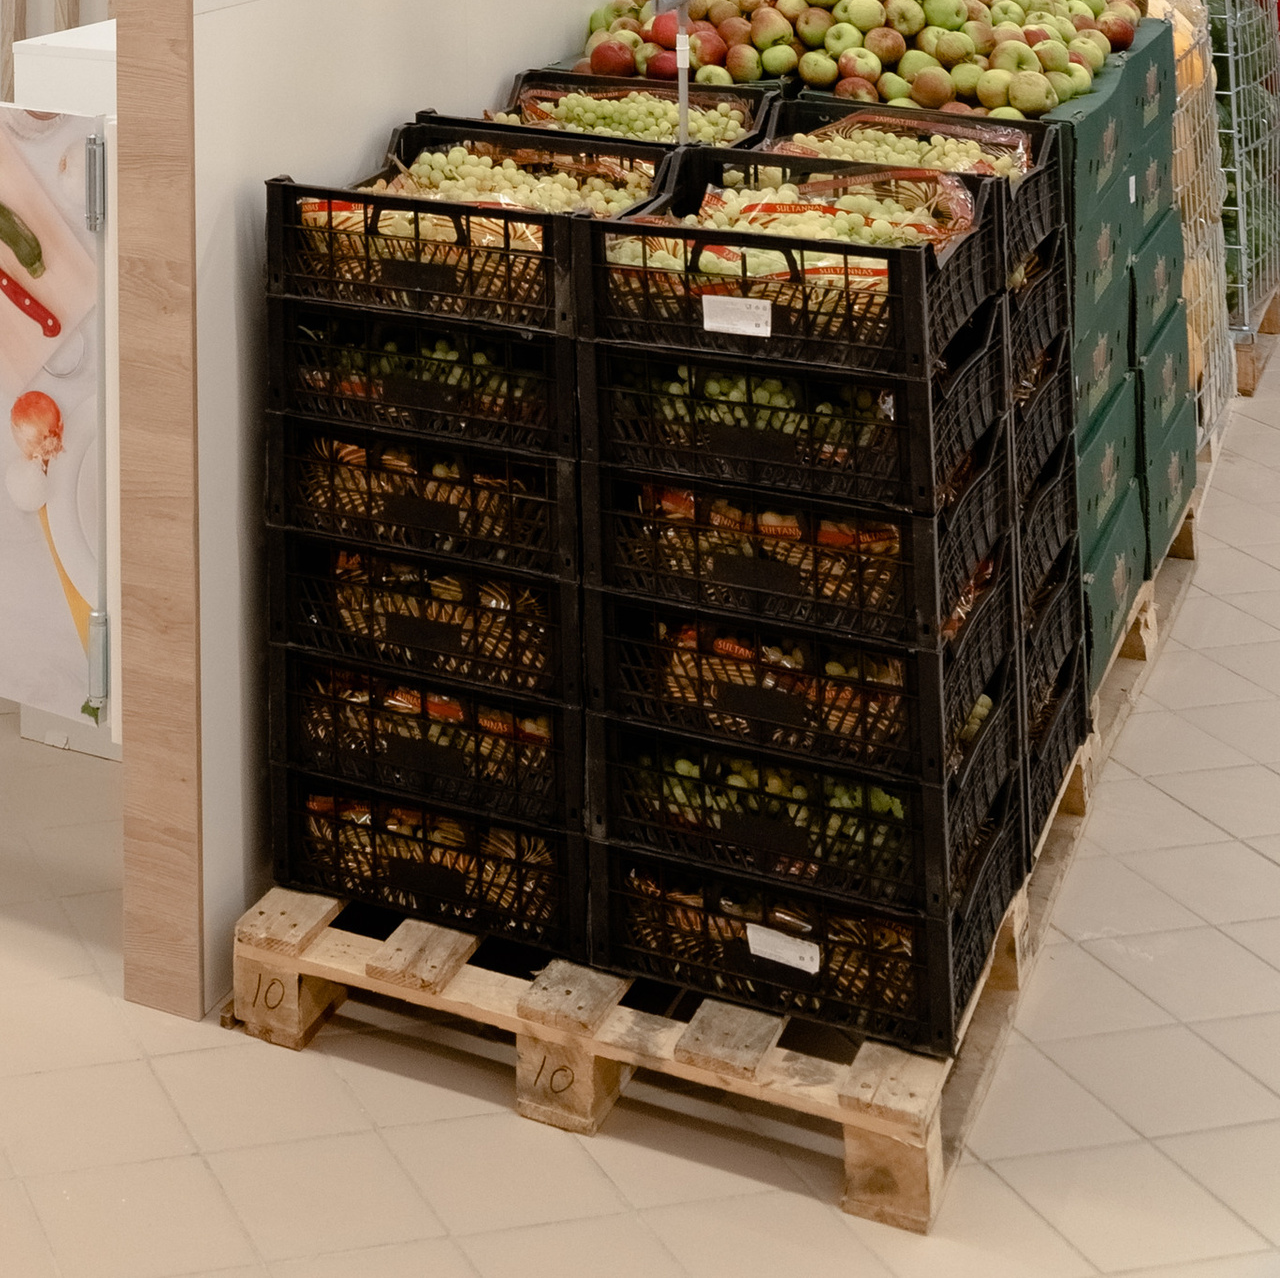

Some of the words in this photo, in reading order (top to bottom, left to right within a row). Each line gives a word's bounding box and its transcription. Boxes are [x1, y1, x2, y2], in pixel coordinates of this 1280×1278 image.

[819, 267, 874, 277] SULTANNAS
[252, 972, 285, 1010] 10
[533, 1055, 575, 1094] 10
